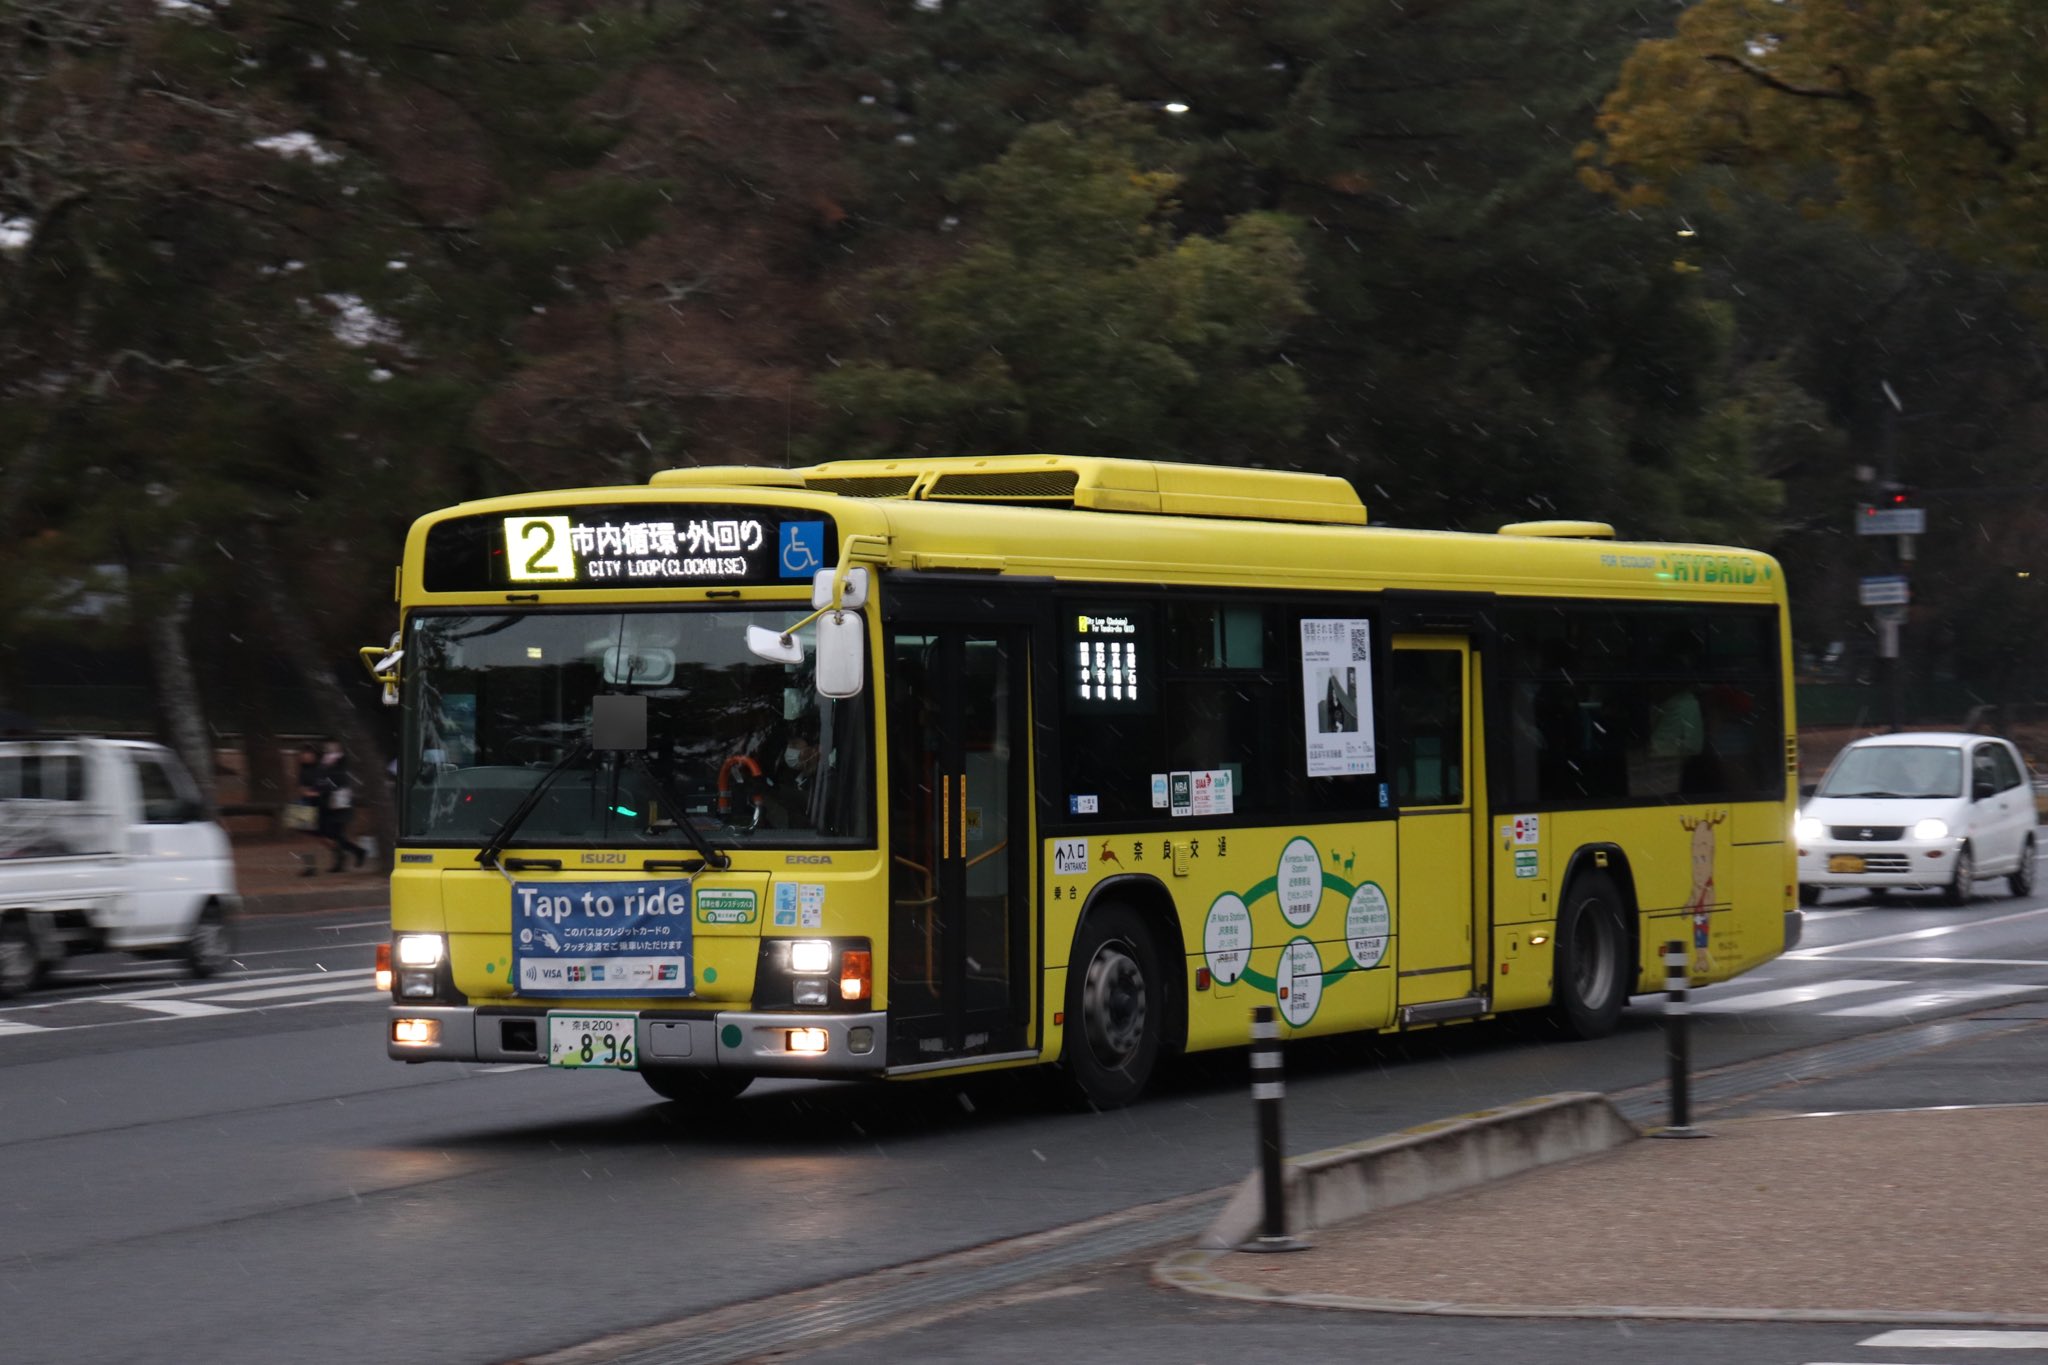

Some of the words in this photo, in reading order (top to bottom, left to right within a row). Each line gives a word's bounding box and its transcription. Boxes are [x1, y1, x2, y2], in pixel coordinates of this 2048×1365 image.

[521, 520, 559, 574] 2
[588, 558, 622, 577] CITY
[629, 556, 747, 576] LOOP(CLOCKWISE)
[1669, 553, 1757, 584] HYBRID
[1067, 844, 1085, 860] 入口
[1133, 836, 1227, 862] 奈良交通
[580, 853, 627, 864] ISUZU
[785, 855, 833, 864] ERGA
[1064, 861, 1087, 872] ENTRANCE
[1291, 864, 1308, 873] Station
[517, 888, 572, 925] Tap
[581, 891, 615, 918] to
[623, 887, 685, 917] ride
[1217, 912, 1229, 922] Nara
[1229, 911, 1247, 922] Station
[563, 926, 671, 938] このバスはクレジットカードの
[542, 968, 563, 979] VISA
